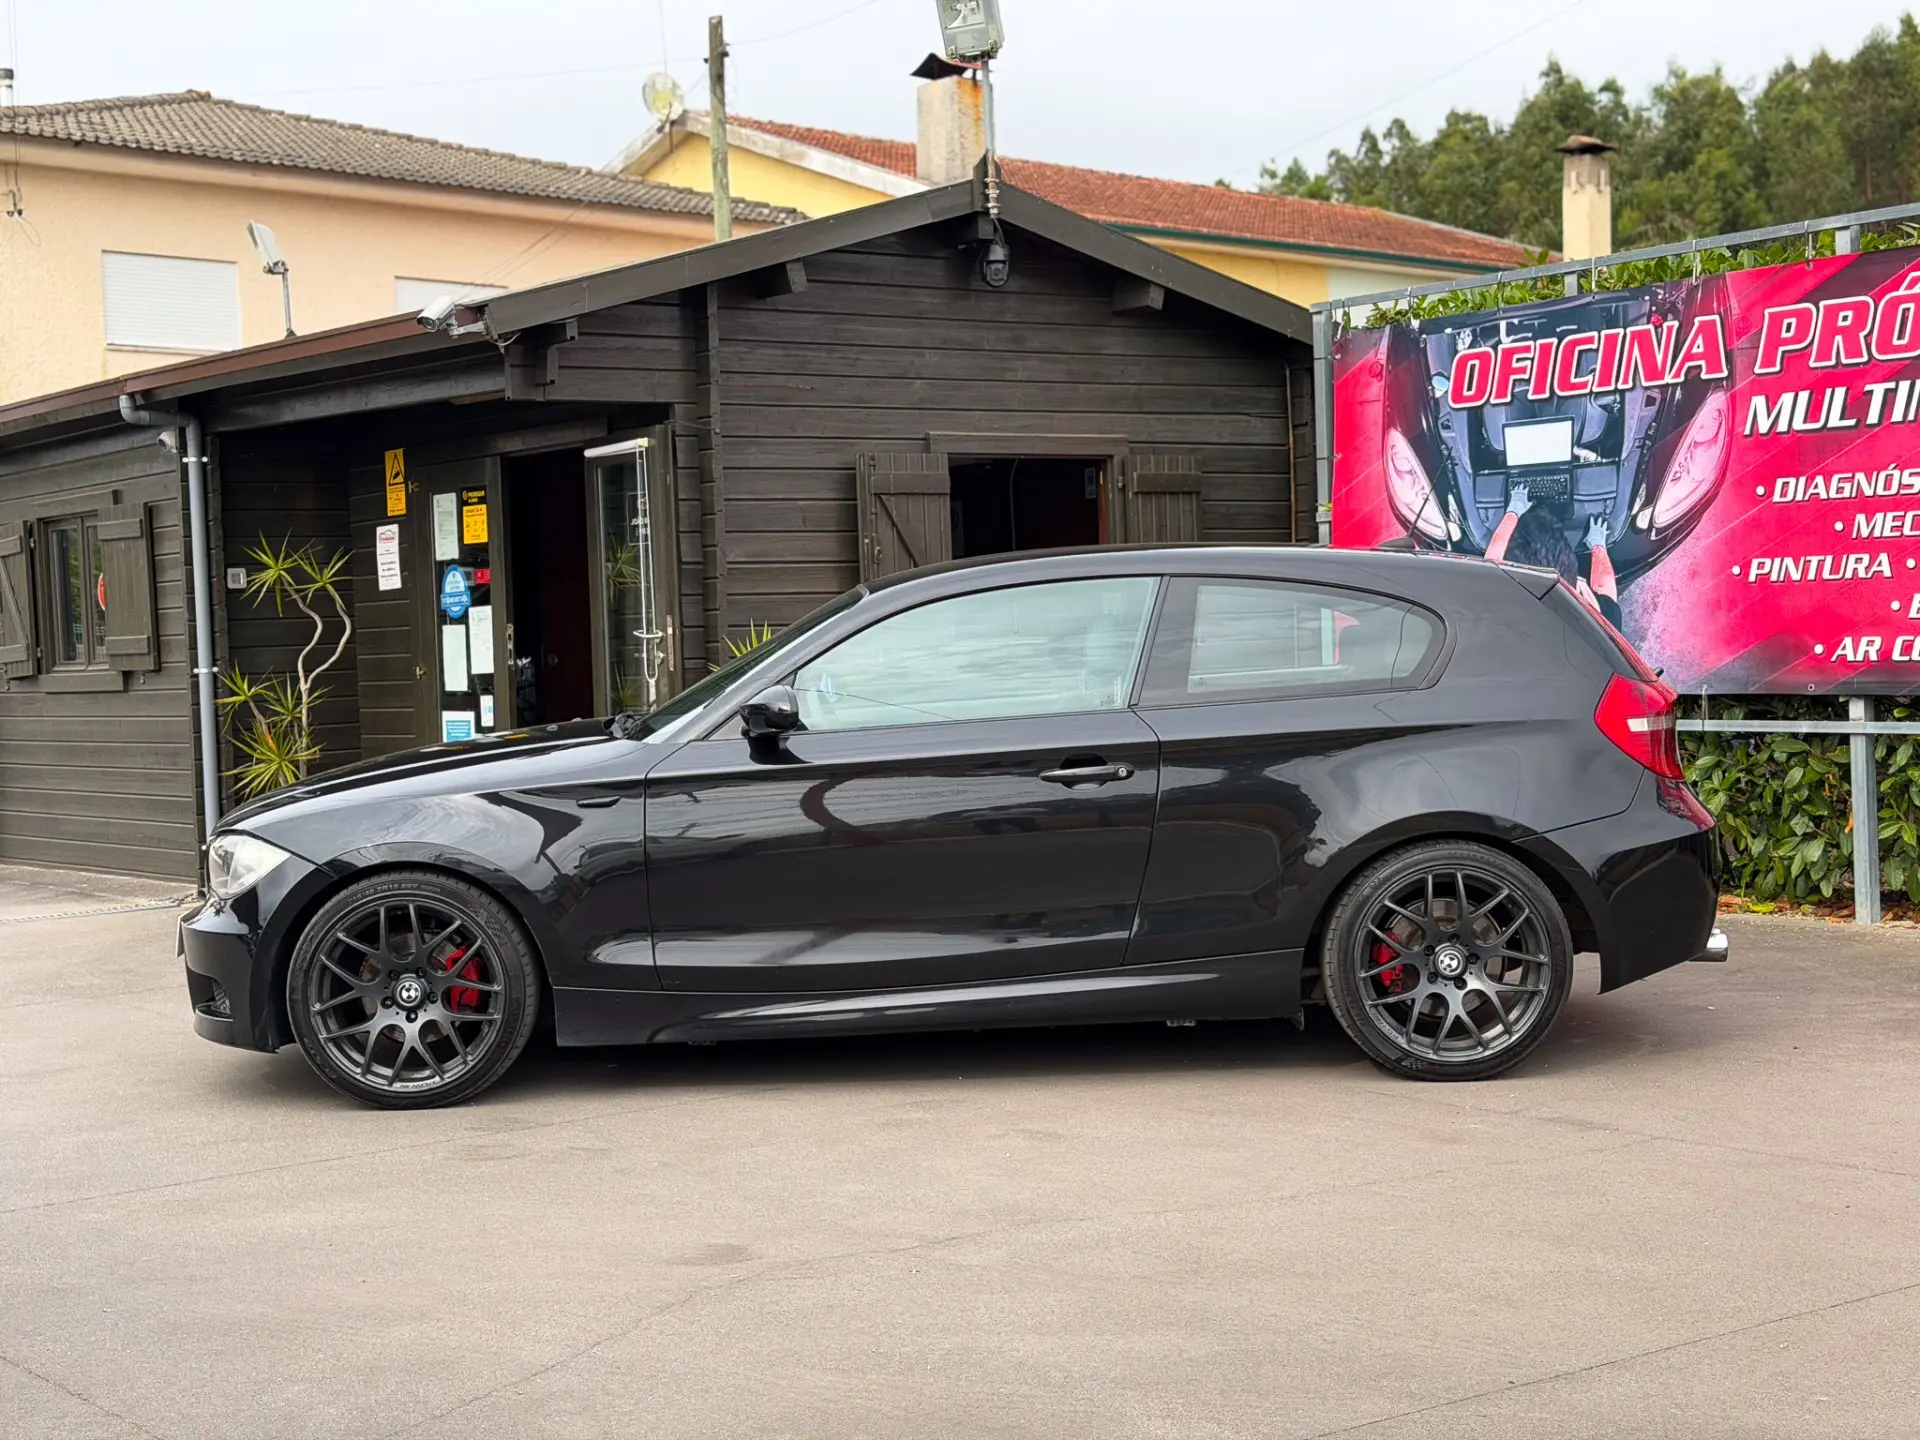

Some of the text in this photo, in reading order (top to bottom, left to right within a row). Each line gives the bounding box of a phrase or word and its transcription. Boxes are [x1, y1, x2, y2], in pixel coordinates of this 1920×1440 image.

[1449, 272, 1920, 409] OFICINA PRÓ
[1772, 463, 1920, 503] DIAGNÓS
[1852, 510, 1920, 539] MEC
[1748, 552, 1893, 583] PINTURA
[1830, 635, 1881, 662] AR
